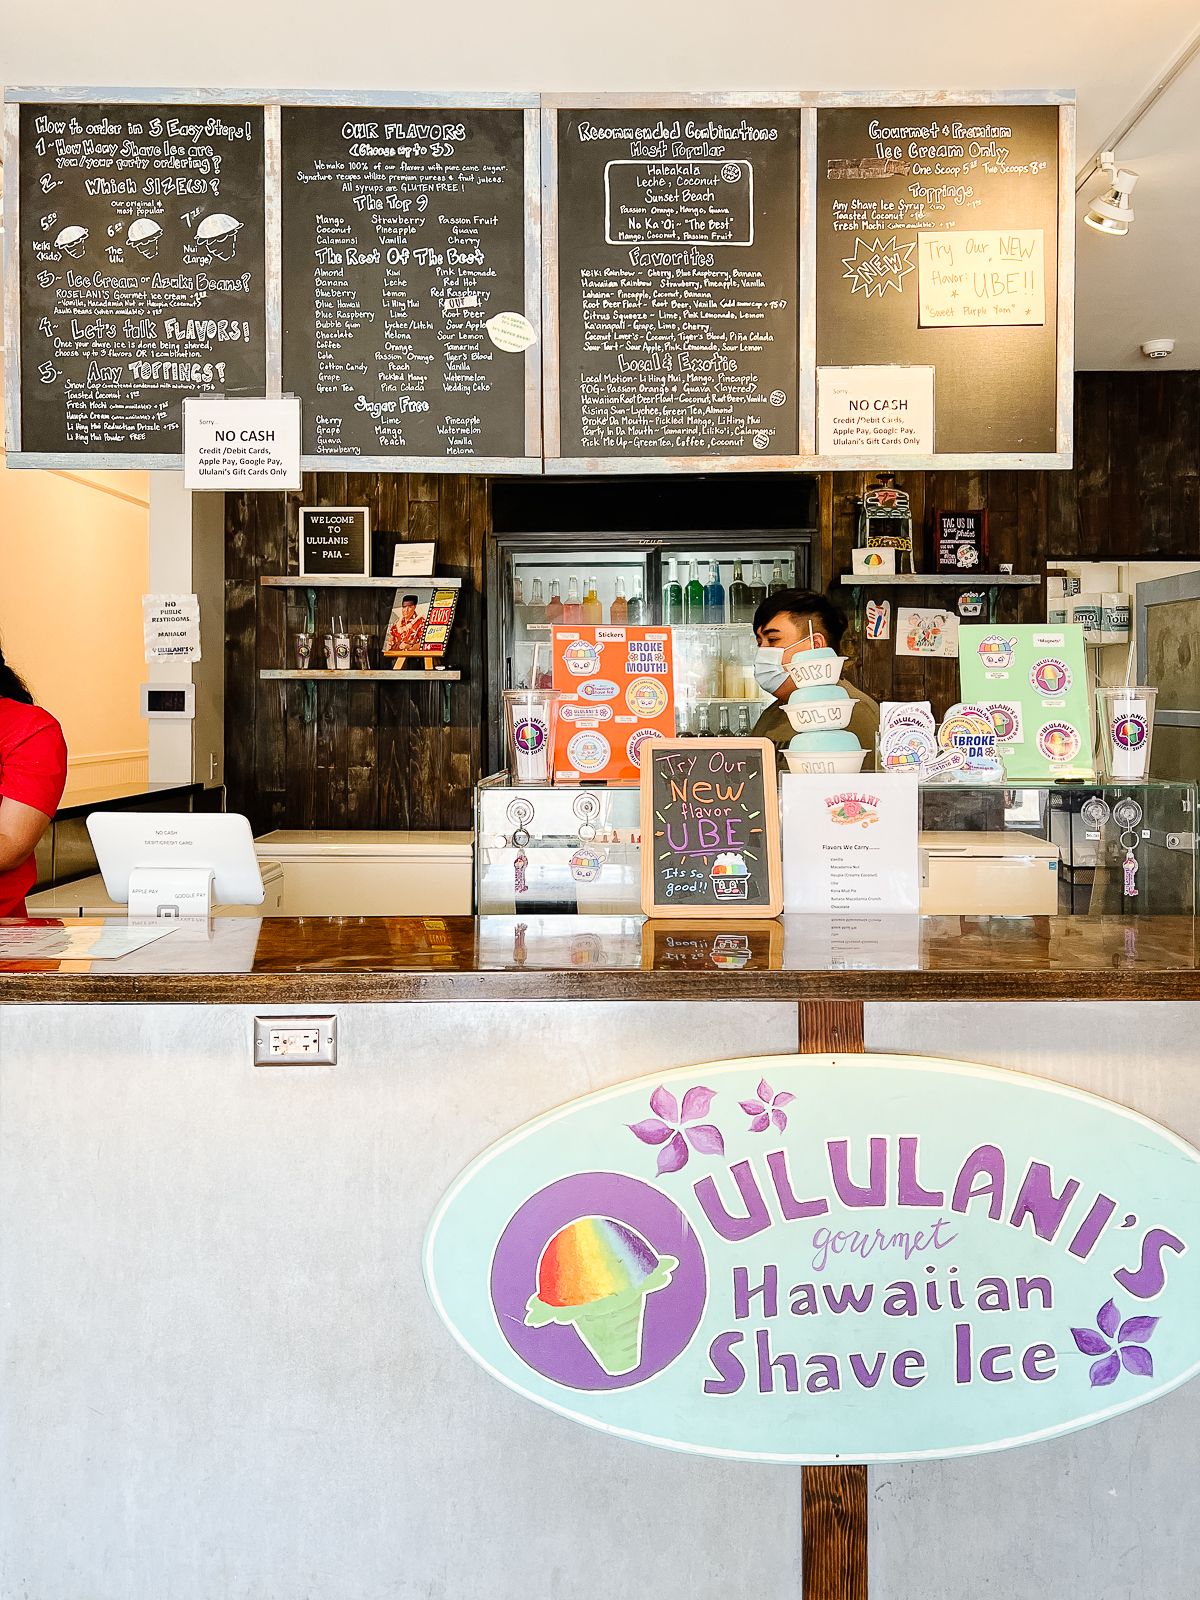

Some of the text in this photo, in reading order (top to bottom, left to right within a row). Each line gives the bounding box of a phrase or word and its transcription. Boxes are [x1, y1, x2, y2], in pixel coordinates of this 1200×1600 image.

[35, 116, 251, 142] How to order in 5 Easy Steps!
[342, 122, 465, 141] OUR FLAVORS
[578, 120, 778, 141] Recommended Combinations
[868, 120, 1012, 140] Gourmet Premium
[630, 142, 725, 159] Most Popular
[876, 142, 1008, 165] Ice Cream Only
[912, 165, 932, 175] One
[935, 165, 960, 177] Scoop
[982, 163, 998, 174] Two
[1000, 163, 1028, 174] Scoops
[85, 178, 136, 195] Which
[909, 182, 973, 205] Toppings
[645, 189, 714, 203] Sunset Beach
[353, 195, 428, 212] The Top 9
[833, 200, 924, 214] Any Shave Ice Syrup
[316, 215, 345, 225] Mango
[372, 214, 425, 226] Strawberry
[438, 216, 498, 225] Passion Fruit
[833, 211, 903, 220] Toasted Coconut
[317, 225, 351, 234] Coconut
[376, 225, 416, 235] Pineapple
[452, 226, 478, 235] Guava
[833, 221, 884, 231] Fresh Mochi
[315, 247, 484, 266] The Rest Of The Best
[629, 247, 714, 266] Favorites
[924, 236, 1035, 266] Try Our NEW
[314, 268, 343, 277] Almond
[436, 268, 497, 277] Pink Lemonade
[857, 253, 902, 284] NEW
[66, 271, 92, 288] Ice
[92, 272, 138, 288] Cream
[152, 273, 193, 289] Azuki
[196, 273, 250, 292] Beans?
[315, 278, 348, 286] Banana
[973, 272, 1034, 298] UBE!!
[315, 289, 356, 299] Blueberry
[963, 307, 987, 318] Purple
[71, 318, 250, 342] Let's talk FLAVORS!
[618, 353, 659, 372] Local
[678, 352, 738, 372] Exotic
[87, 361, 226, 382] Any TOPPINGS?
[64, 391, 121, 400] Toasted Coconut
[354, 396, 429, 418] Sugar Free
[850, 400, 908, 410] NO CASH
[215, 430, 275, 442] NO CASH
[249, 448, 271, 456] Cards,
[199, 458, 283, 466] Apple Pay, Google Pay,
[199, 468, 287, 477] Ululani's Gift Cards Only
[942, 518, 974, 528] TAG US IN
[943, 528, 976, 539] your photos
[307, 537, 348, 545] ULULANIS
[430, 608, 450, 624] ELVIS
[629, 642, 662, 652] BROKE
[640, 653, 653, 661] DA
[627, 663, 666, 672] MOUTH!
[1041, 723, 1075, 734] ULULANI'S
[959, 736, 995, 745] BROKE
[969, 747, 984, 757] DA
[656, 752, 746, 775] Try Our
[670, 779, 744, 803] New
[824, 793, 880, 808] ROSELANI
[682, 803, 732, 820] flavor
[667, 818, 744, 850] UBE
[662, 868, 703, 879] Its so
[666, 881, 707, 897] good!!
[692, 1136, 1187, 1300] ULULANI'S
[811, 1217, 960, 1271] gourmet
[732, 1265, 1054, 1320] Hawaiian
[702, 1322, 1057, 1396] Shave Ice
